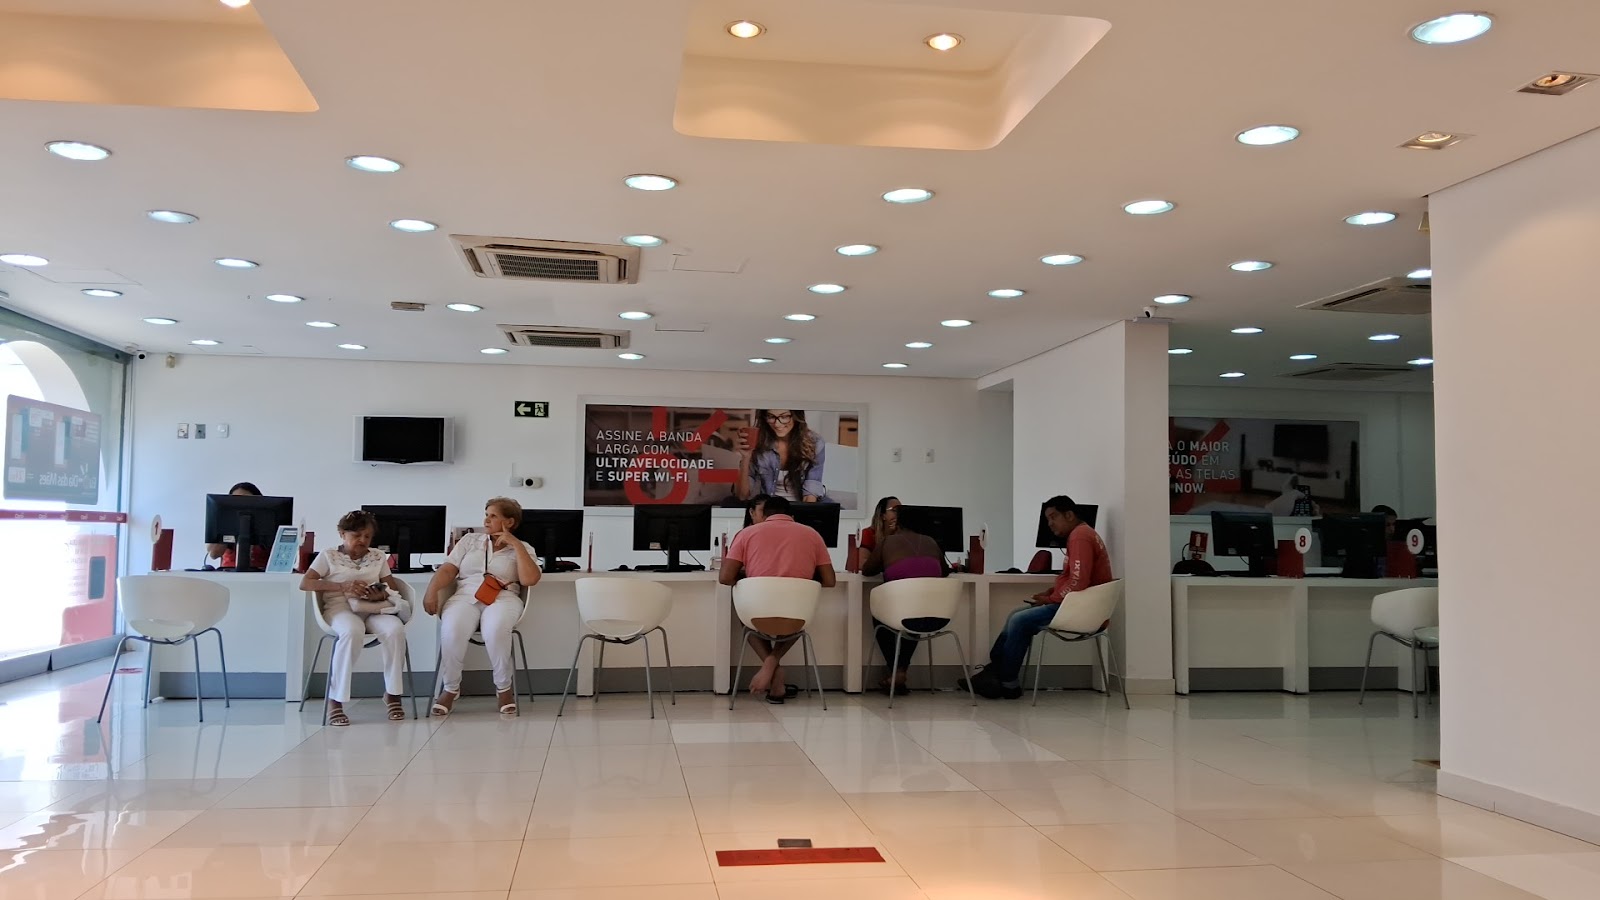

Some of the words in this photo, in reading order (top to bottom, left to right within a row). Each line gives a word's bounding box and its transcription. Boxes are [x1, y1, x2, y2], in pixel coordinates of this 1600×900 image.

[596, 430, 642, 441] ASSINE
[646, 431, 655, 441] A
[659, 431, 702, 442] BANDA
[596, 444, 639, 454] LARGA
[643, 444, 669, 455] COM
[1177, 440, 1185, 451] O
[1190, 441, 1229, 452] MAIOR
[595, 457, 714, 469] ULTRAVELOCIDADE
[1202, 454, 1219, 466] EM
[596, 471, 604, 481] E
[608, 471, 650, 482] SUPER
[654, 472, 691, 482] WI-FI.
[1176, 468, 1192, 479] AS
[1196, 468, 1236, 480] TELAS
[1174, 482, 1206, 493] NOW.
[1299, 535, 1306, 548] 8
[1411, 534, 1419, 547] 9
